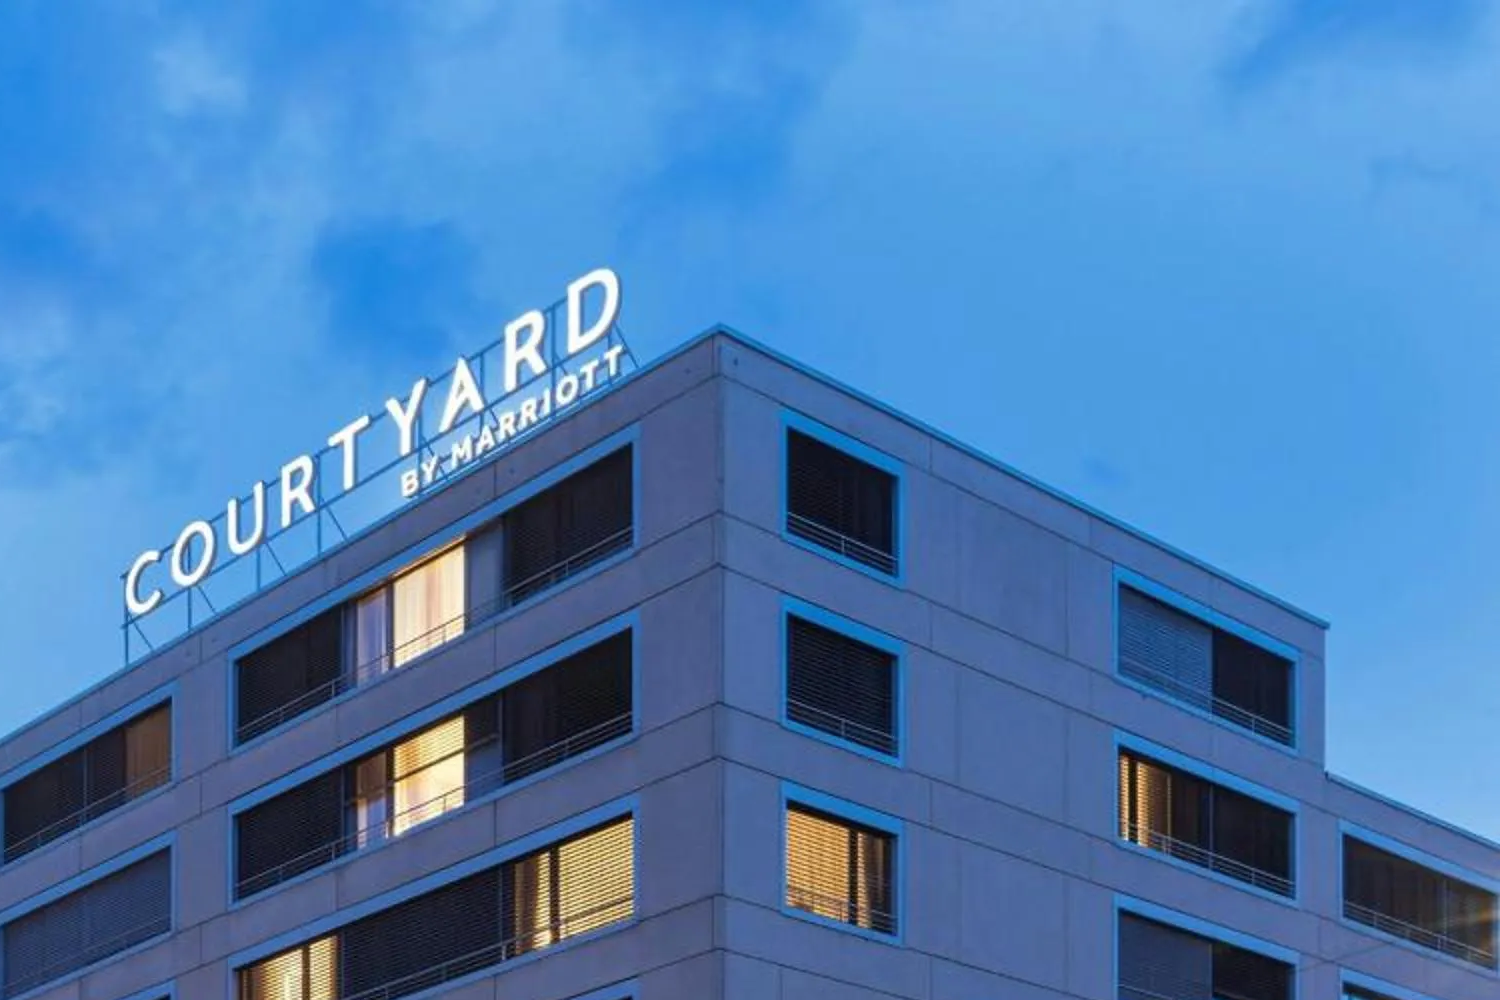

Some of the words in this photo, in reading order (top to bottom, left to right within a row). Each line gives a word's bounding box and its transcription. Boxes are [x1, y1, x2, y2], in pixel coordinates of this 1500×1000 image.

[125, 268, 621, 615] COURTYARD
[401, 454, 439, 498] BY
[451, 344, 624, 468] MARRIOTT
